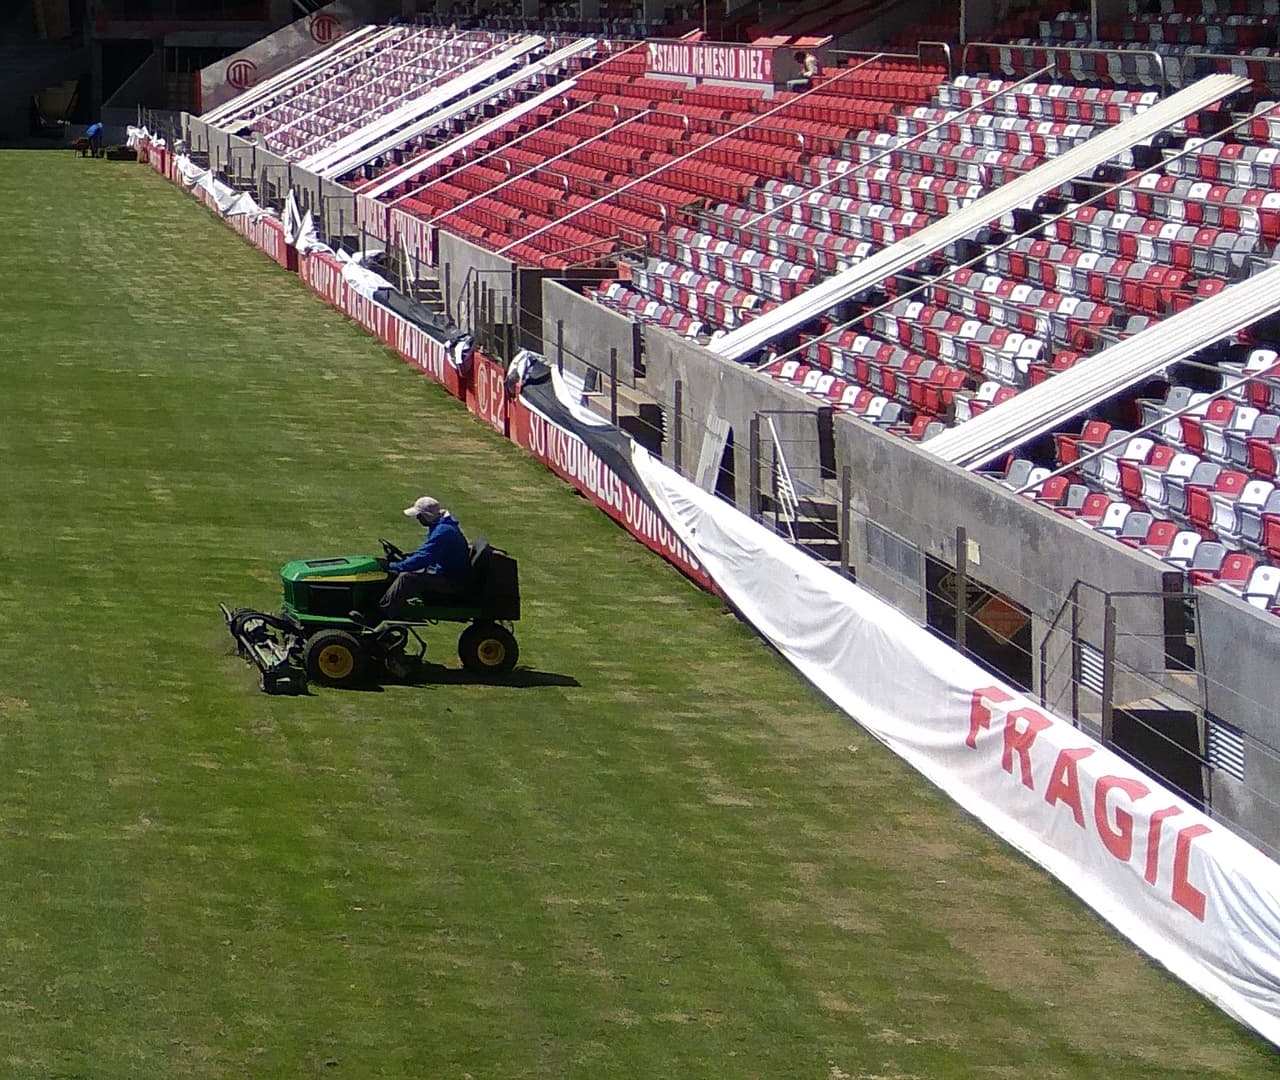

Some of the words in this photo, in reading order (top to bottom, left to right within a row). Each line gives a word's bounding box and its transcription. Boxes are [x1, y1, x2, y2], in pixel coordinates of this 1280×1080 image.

[692, 44, 735, 78] NEMESIO
[739, 49, 763, 80] DIEZ
[965, 686, 1212, 923] FRAGIL
